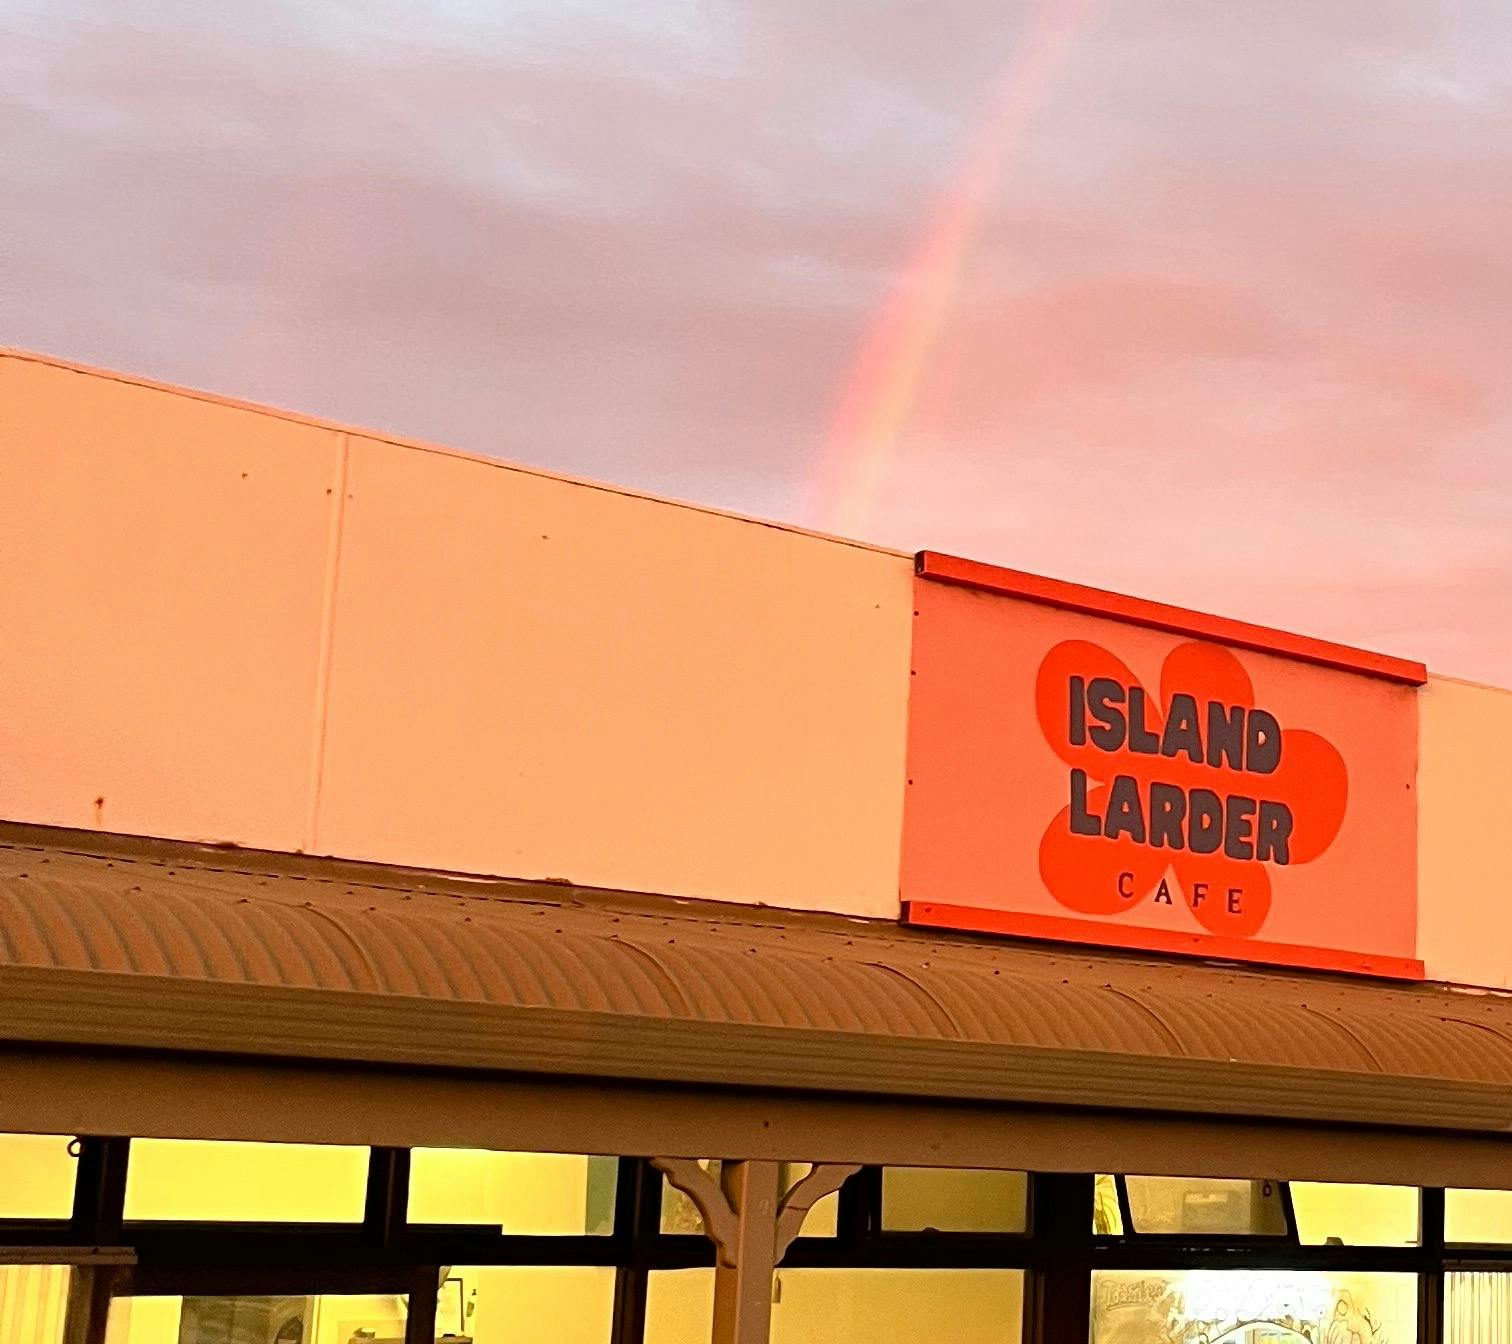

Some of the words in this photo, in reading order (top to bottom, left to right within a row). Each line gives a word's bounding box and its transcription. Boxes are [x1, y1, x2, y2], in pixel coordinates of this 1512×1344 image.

[1069, 675, 1282, 775] ISLAND
[1069, 768, 1293, 866] LARDER
[1118, 872, 1243, 914] CAFE
